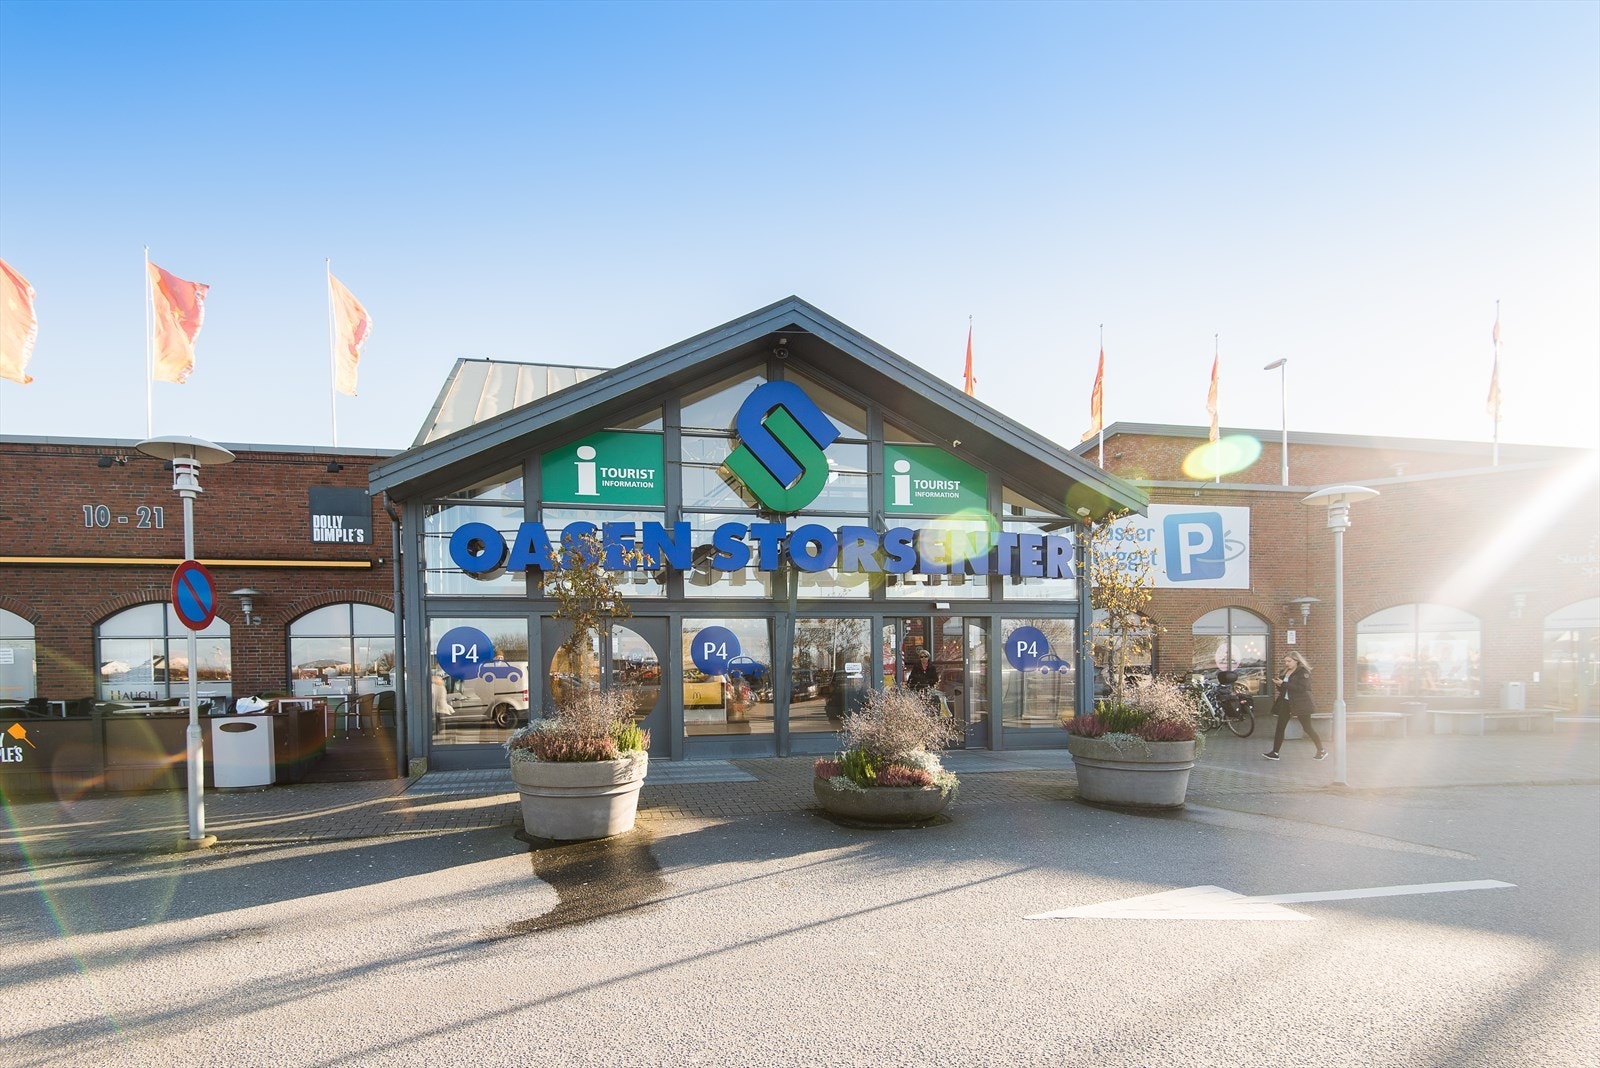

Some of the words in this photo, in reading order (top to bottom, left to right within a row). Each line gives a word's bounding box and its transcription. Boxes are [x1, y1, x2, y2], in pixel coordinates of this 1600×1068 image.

[600, 467, 655, 480] TOURIST
[601, 480, 654, 488] INFORMATION
[913, 479, 961, 490] TOURIST
[83, 504, 110, 528] 10
[136, 505, 164, 529] 21
[312, 514, 343, 529] DOLLY
[449, 521, 692, 573] OASEN
[712, 522, 1075, 579] STORSENTER
[1178, 522, 1214, 575] P
[451, 643, 480, 664] P4
[703, 642, 728, 660] P4
[1017, 640, 1038, 658] P4
